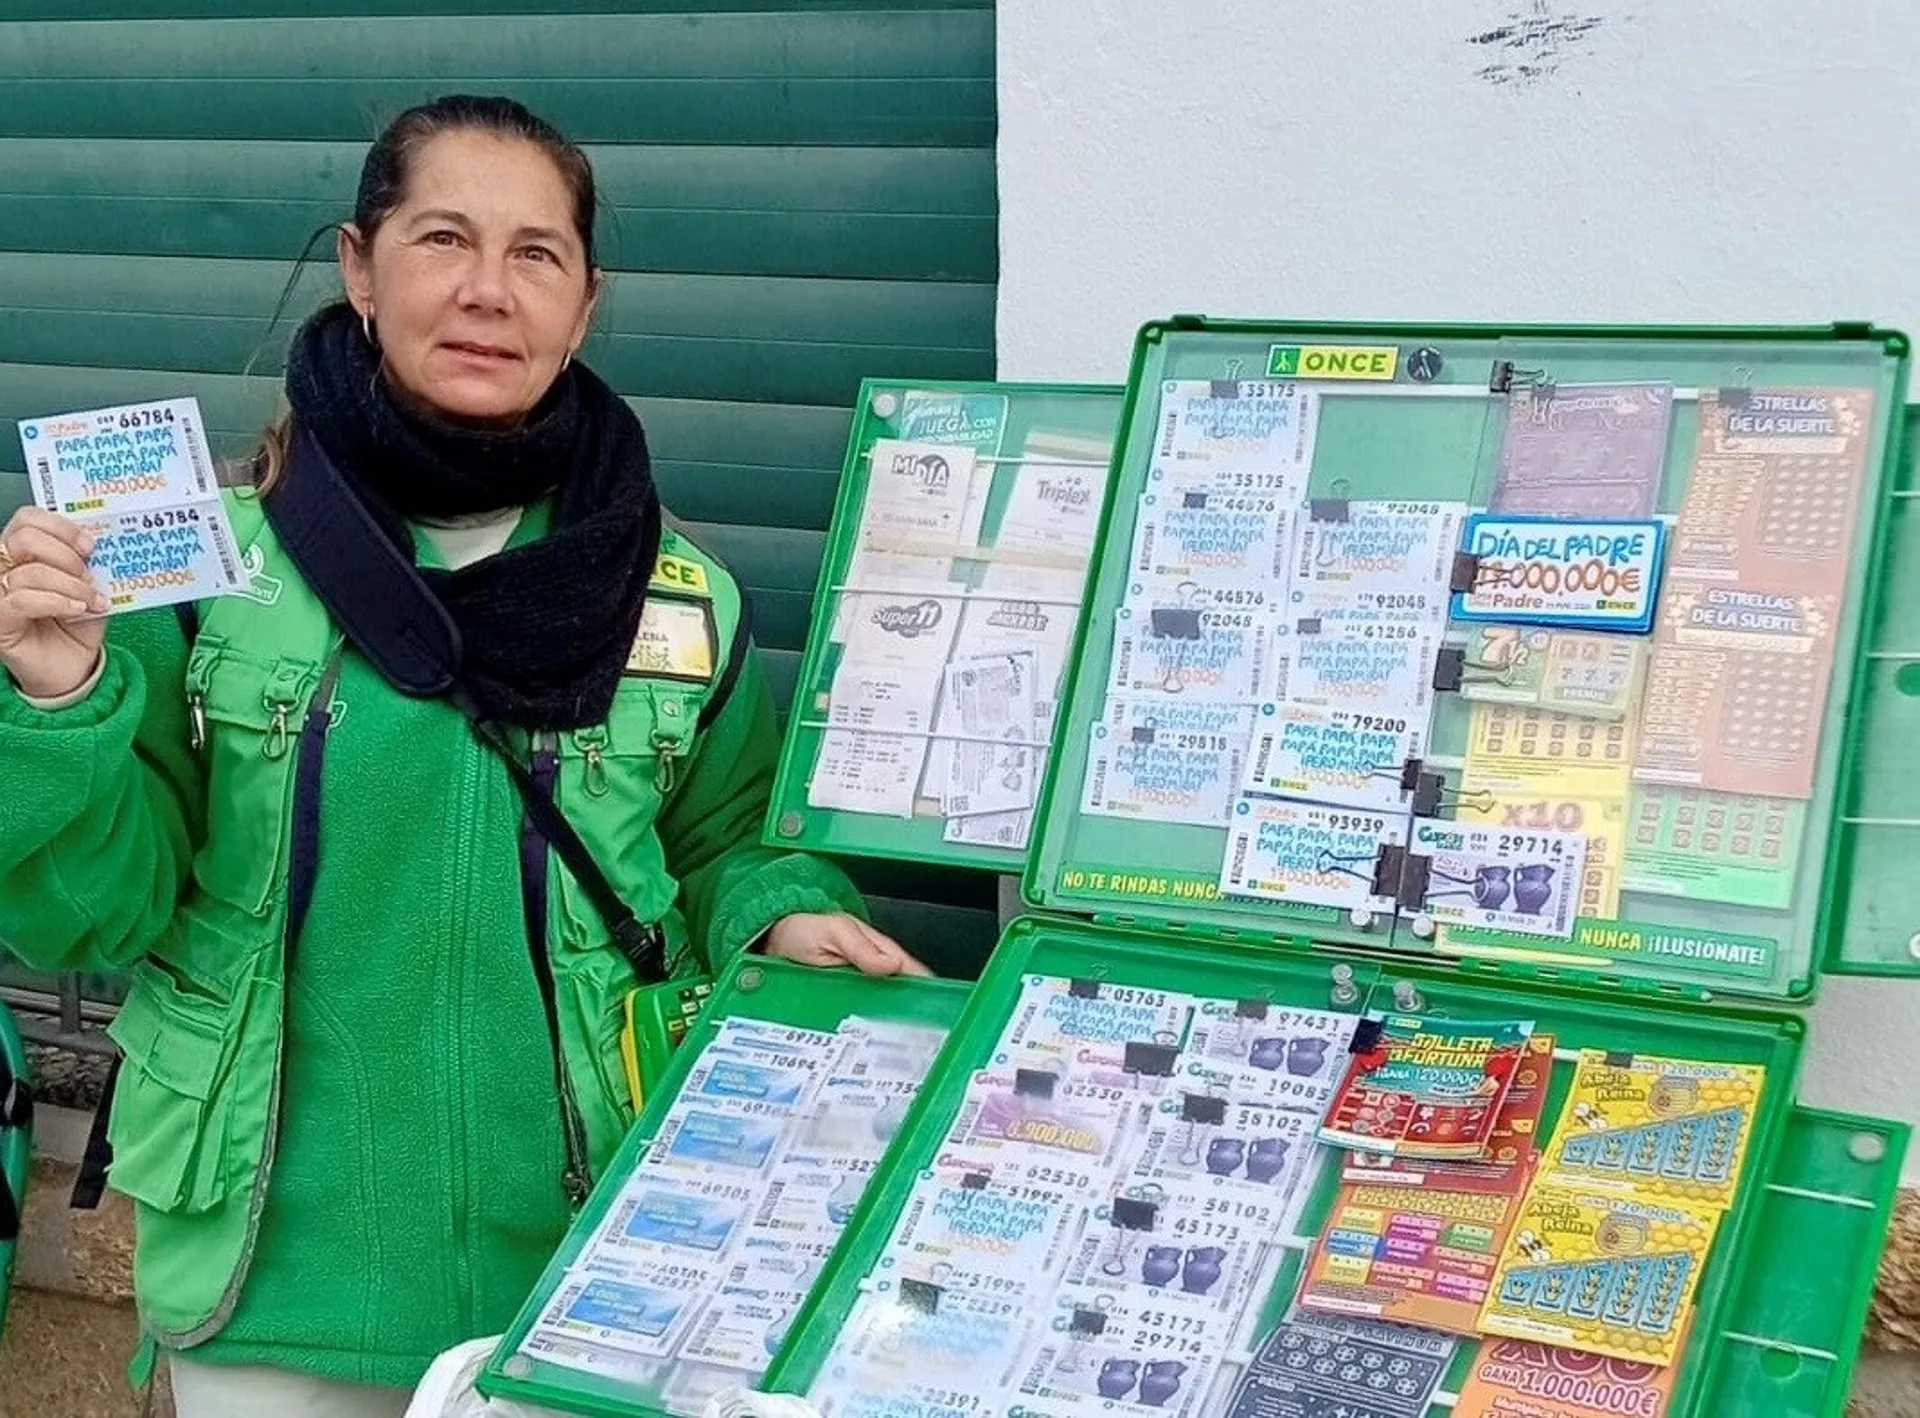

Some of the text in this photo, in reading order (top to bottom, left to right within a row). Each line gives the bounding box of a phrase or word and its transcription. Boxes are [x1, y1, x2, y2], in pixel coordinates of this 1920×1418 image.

[1304, 353, 1388, 373] ONCE
[1247, 384, 1296, 398] 35175
[1750, 395, 1828, 412] STRELLAS
[119, 407, 174, 429] 66784
[1730, 415, 1837, 435] DE LA SUERTE
[1233, 473, 1284, 488] 35175
[142, 508, 200, 529] 66784
[1387, 503, 1440, 516] 92048
[1478, 530, 1520, 559] DÍA
[1524, 537, 1561, 561] DEL
[1564, 534, 1645, 566] PADRE
[1376, 594, 1427, 609] 92048
[1493, 594, 1543, 608] Padre
[1708, 588, 1795, 611] ESTRELLAS
[1201, 613, 1252, 628] 92048
[1691, 608, 1802, 632] DE LA SUERTE
[1353, 714, 1407, 734] 79200
[1329, 814, 1384, 833] 93939
[1498, 835, 1564, 855] 29714
[1062, 871, 1085, 888] NO
[1089, 873, 1106, 889] TE
[1111, 875, 1168, 895] RINDAS
[1580, 928, 1766, 965] NUNCA ¡ILUSIÓNATE!
[1114, 989, 1167, 1008] 05763
[1279, 1012, 1341, 1031] 97431
[1269, 1078, 1331, 1101] 19085
[1238, 1109, 1303, 1132] 58102
[1027, 1164, 1090, 1189] 62530
[1008, 1186, 1064, 1205] 51992
[1203, 1198, 1271, 1222] 58102
[1174, 1217, 1241, 1241] 45173
[968, 1273, 1027, 1296] 51992
[1138, 1310, 1207, 1335] 45173
[1134, 1330, 1202, 1354] 29714
[1482, 1365, 1519, 1384] GANA
[1520, 1368, 1658, 1416] 1.000.000€
